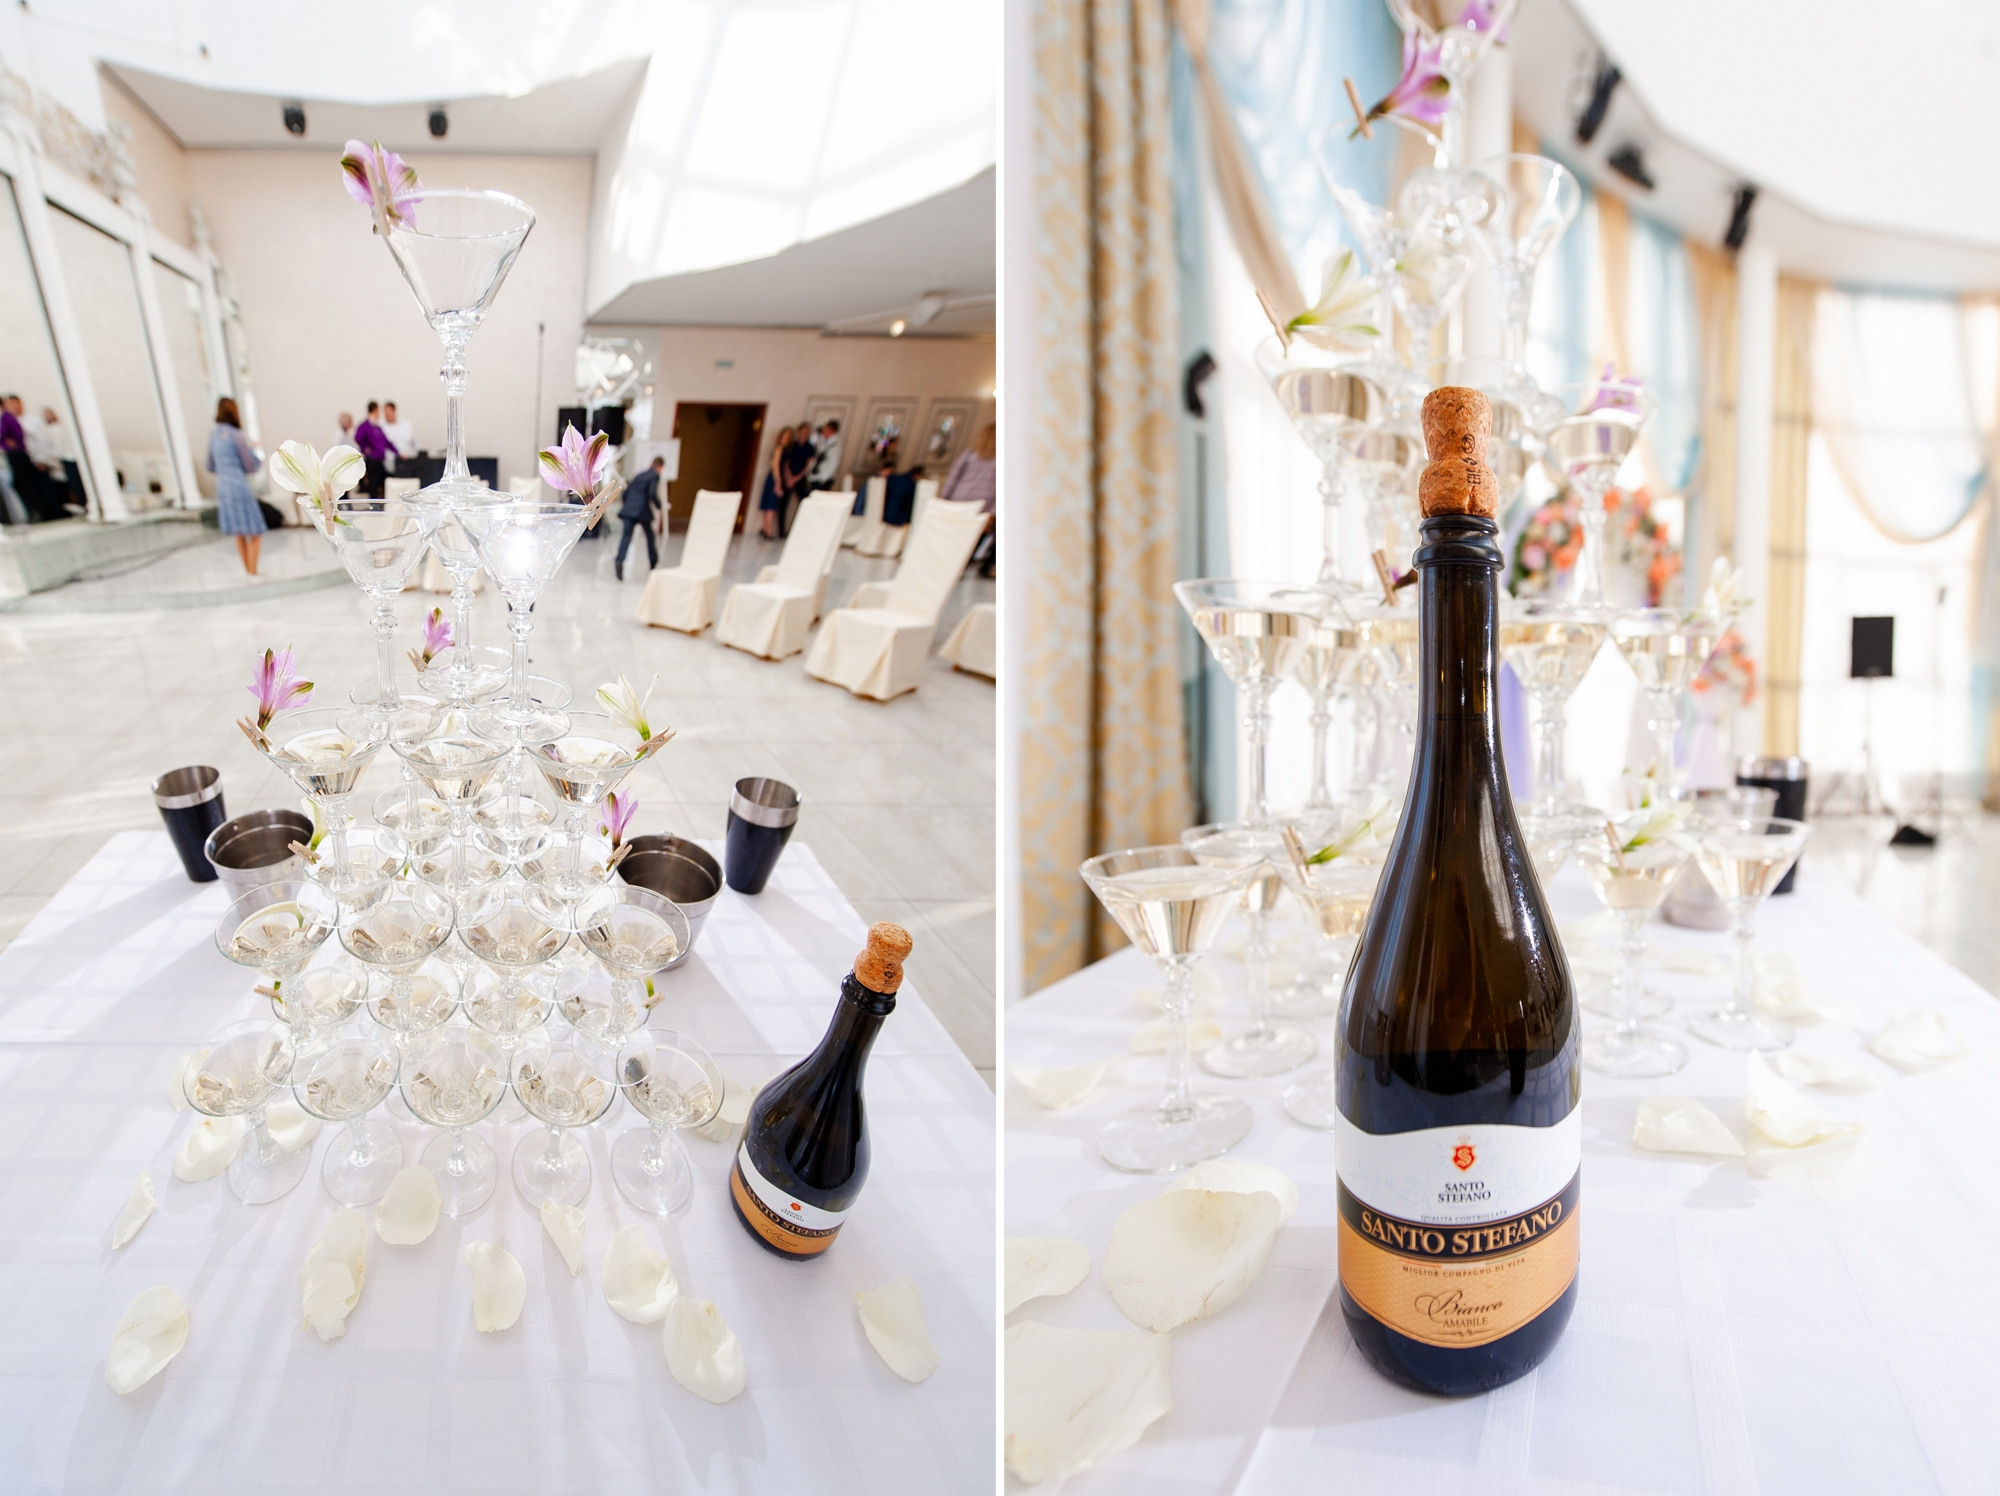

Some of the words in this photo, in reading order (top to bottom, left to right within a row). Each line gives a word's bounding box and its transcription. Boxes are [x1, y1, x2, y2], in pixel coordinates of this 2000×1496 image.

[1444, 1181, 1485, 1194] SANTO
[1437, 1190, 1491, 1203] STEFANO
[745, 1184, 780, 1223] SANTO
[781, 1220, 836, 1237] STEFANO
[1455, 1210, 1507, 1223] CONTROLLATA
[1361, 1210, 1446, 1254] SANTO
[1451, 1200, 1563, 1255] STEFANO
[1402, 1265, 1440, 1277] MIGLIOR
[1442, 1268, 1492, 1278] COMPAGNO
[1495, 1264, 1504, 1272] DI
[1507, 1258, 1526, 1269] VITA
[1414, 1289, 1502, 1323] Bianco
[1443, 1317, 1489, 1328] AMABILE
